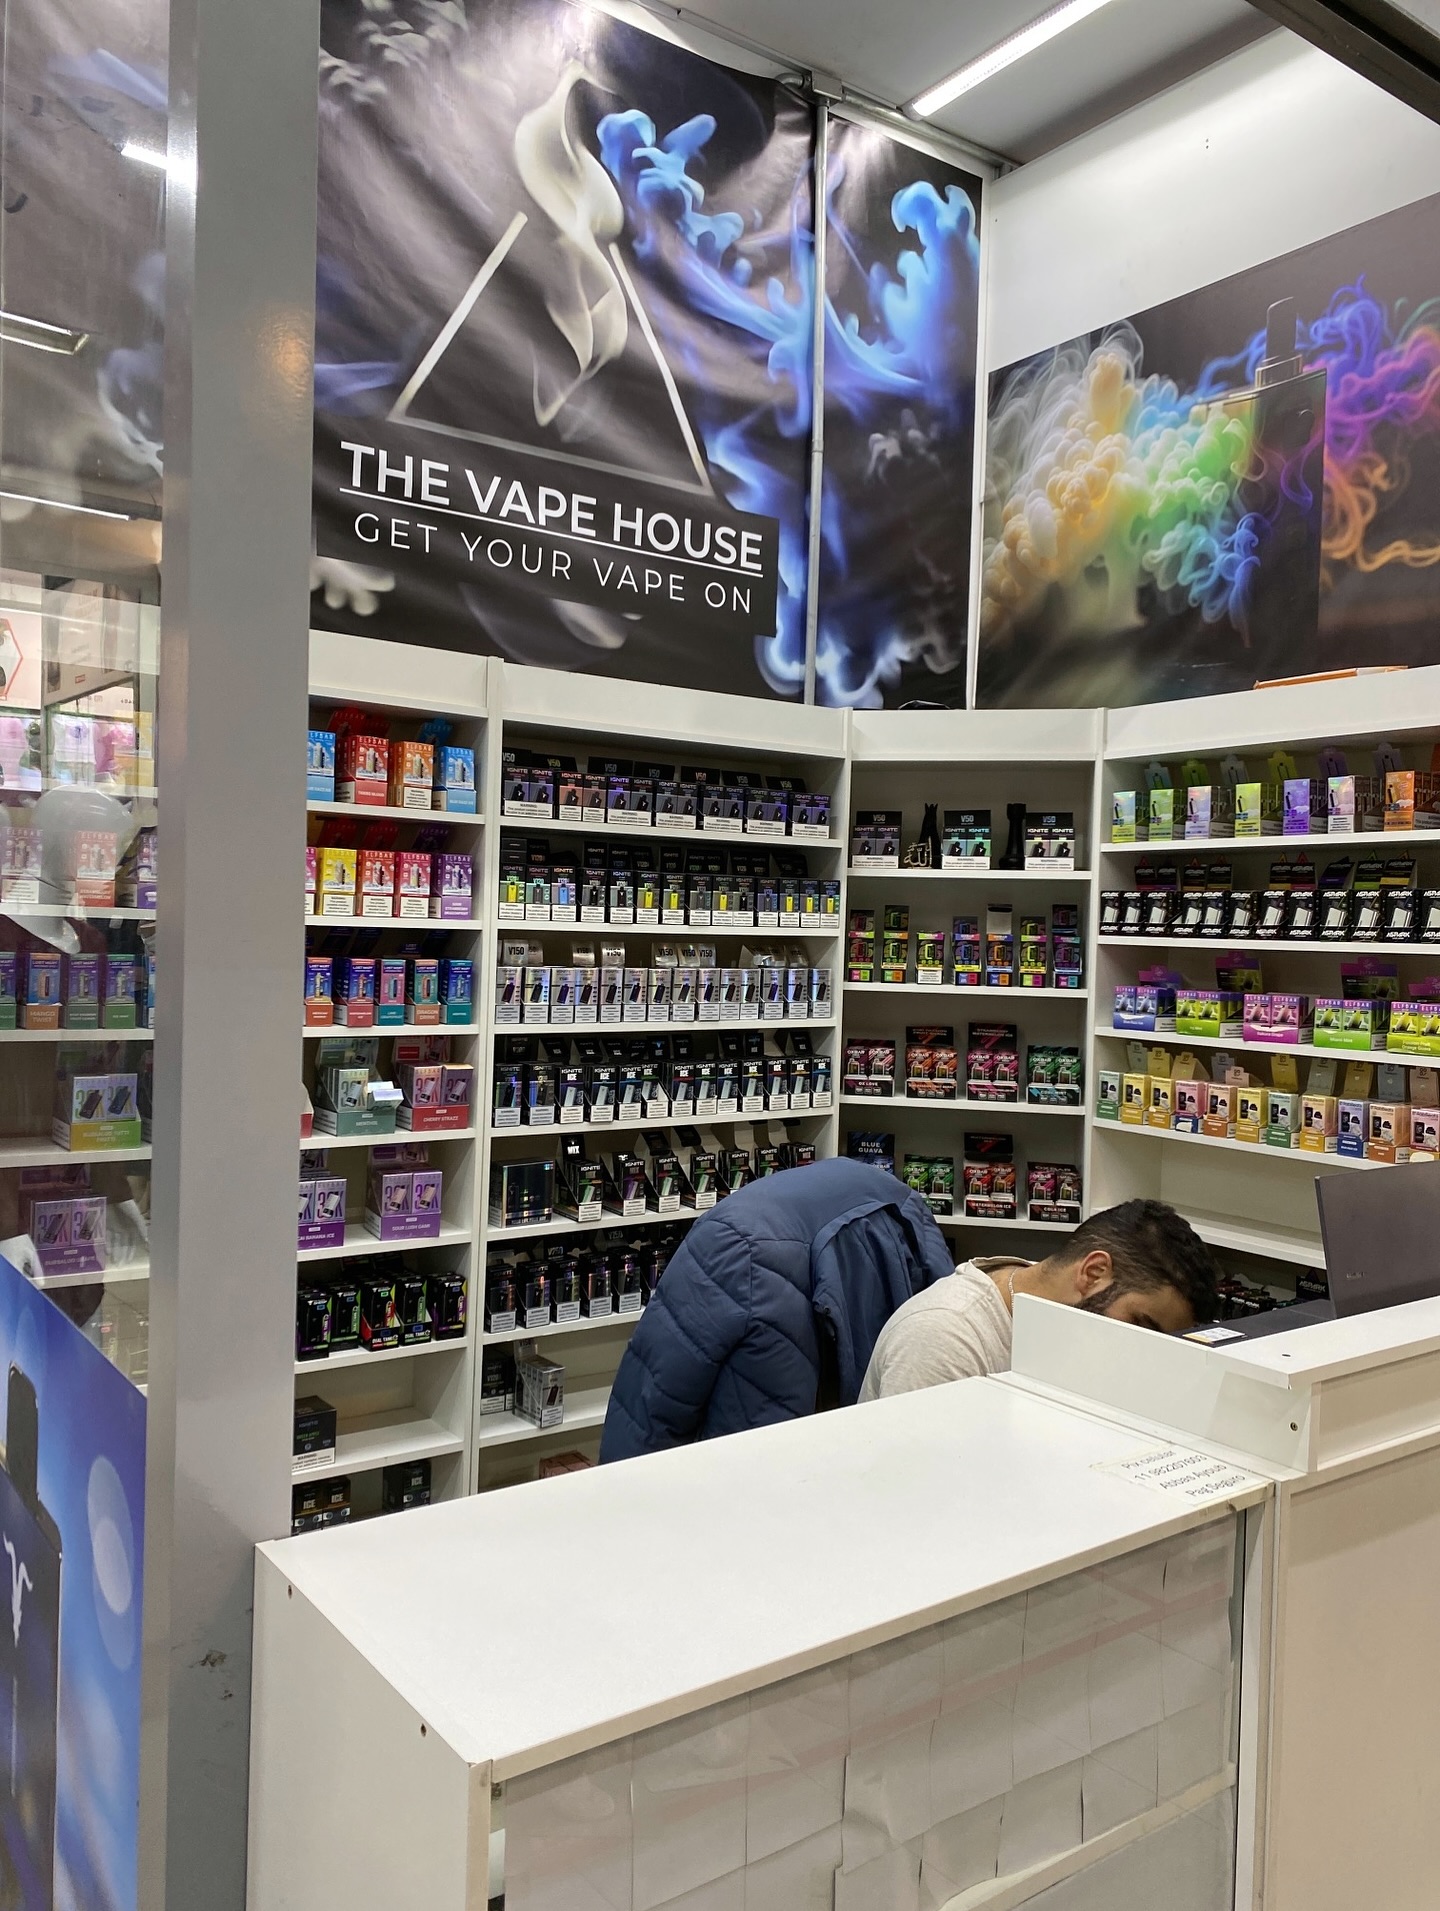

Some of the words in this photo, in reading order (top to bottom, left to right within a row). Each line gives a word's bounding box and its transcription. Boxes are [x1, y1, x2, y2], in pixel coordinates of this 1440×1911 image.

[341, 441, 450, 506] THE
[464, 469, 597, 537] VAPE
[613, 503, 763, 571] HOUSE
[354, 513, 438, 554] GET
[460, 532, 571, 580] YOUR
[592, 558, 685, 602] VAPE
[705, 582, 752, 614] ON
[308, 732, 334, 740] LFBAR
[358, 736, 388, 746] ELFBAR
[405, 743, 432, 752] ELFBAR
[448, 746, 474, 755] ELFBAR
[502, 752, 516, 763] V50
[547, 758, 561, 768] V50
[604, 763, 617, 773] V50
[561, 772, 582, 780] IGNITE
[695, 771, 707, 781] V50
[736, 775, 749, 784] V50
[780, 780, 792, 789] V50
[872, 814, 886, 822] V50
[960, 814, 975, 823] V50
[1042, 815, 1057, 824] V50
[6, 829, 41, 837] ELFBAR
[365, 851, 393, 859] ELFBAR
[402, 852, 430, 861] ELFBAR
[444, 854, 472, 862] ELFBAR
[508, 946, 525, 956] V150
[658, 949, 674, 957] V150
[699, 949, 713, 958] V150
[748, 1065, 758, 1073] ICE
[773, 1064, 782, 1072] ICE
[796, 1063, 805, 1071] ICE
[818, 1062, 826, 1070] ICE
[626, 1071, 636, 1079] ICE
[643, 1068, 653, 1076] ICE
[679, 1069, 689, 1078] ICE
[701, 1068, 711, 1076] ICE
[724, 1067, 733, 1075] ICE
[566, 1073, 577, 1081] ICE
[600, 1072, 610, 1080] ICE
[658, 1156, 678, 1164] IGNITE
[411, 1476, 423, 1487] ICE
[331, 1493, 344, 1503] ICE
[302, 1499, 317, 1510] ICE
